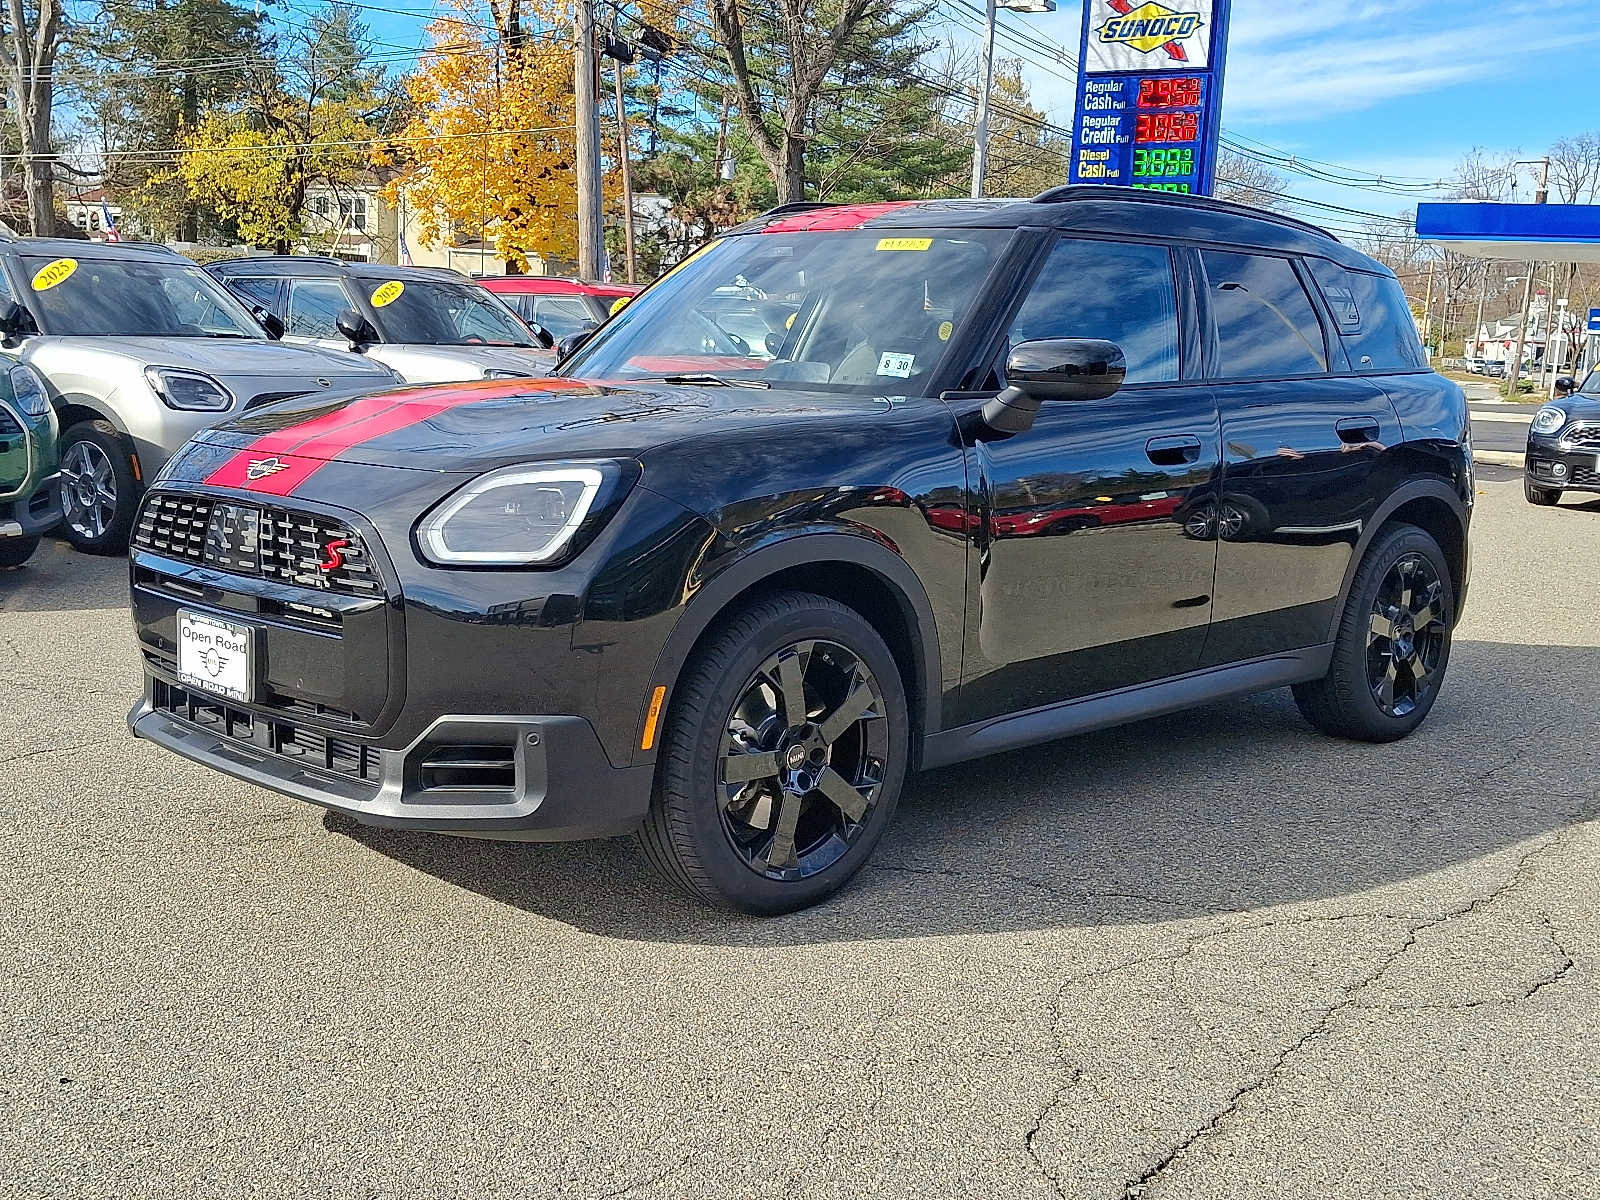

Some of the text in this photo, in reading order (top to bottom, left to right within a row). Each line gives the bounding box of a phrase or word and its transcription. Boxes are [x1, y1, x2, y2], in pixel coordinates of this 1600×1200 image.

[1104, 16, 1195, 38] SUNOCO
[1085, 80, 1123, 94] Regular
[1084, 93, 1126, 110] Cash Full
[1082, 115, 1121, 129] Regular
[1081, 128, 1129, 144] Credit Full
[1080, 149, 1110, 161] Diesel
[1078, 161, 1120, 178] Cash Full
[39, 261, 70, 286] 2025
[376, 282, 399, 303] 2025
[884, 360, 909, 371] 8 30
[320, 540, 348, 569] S
[182, 626, 247, 653] Open Road
